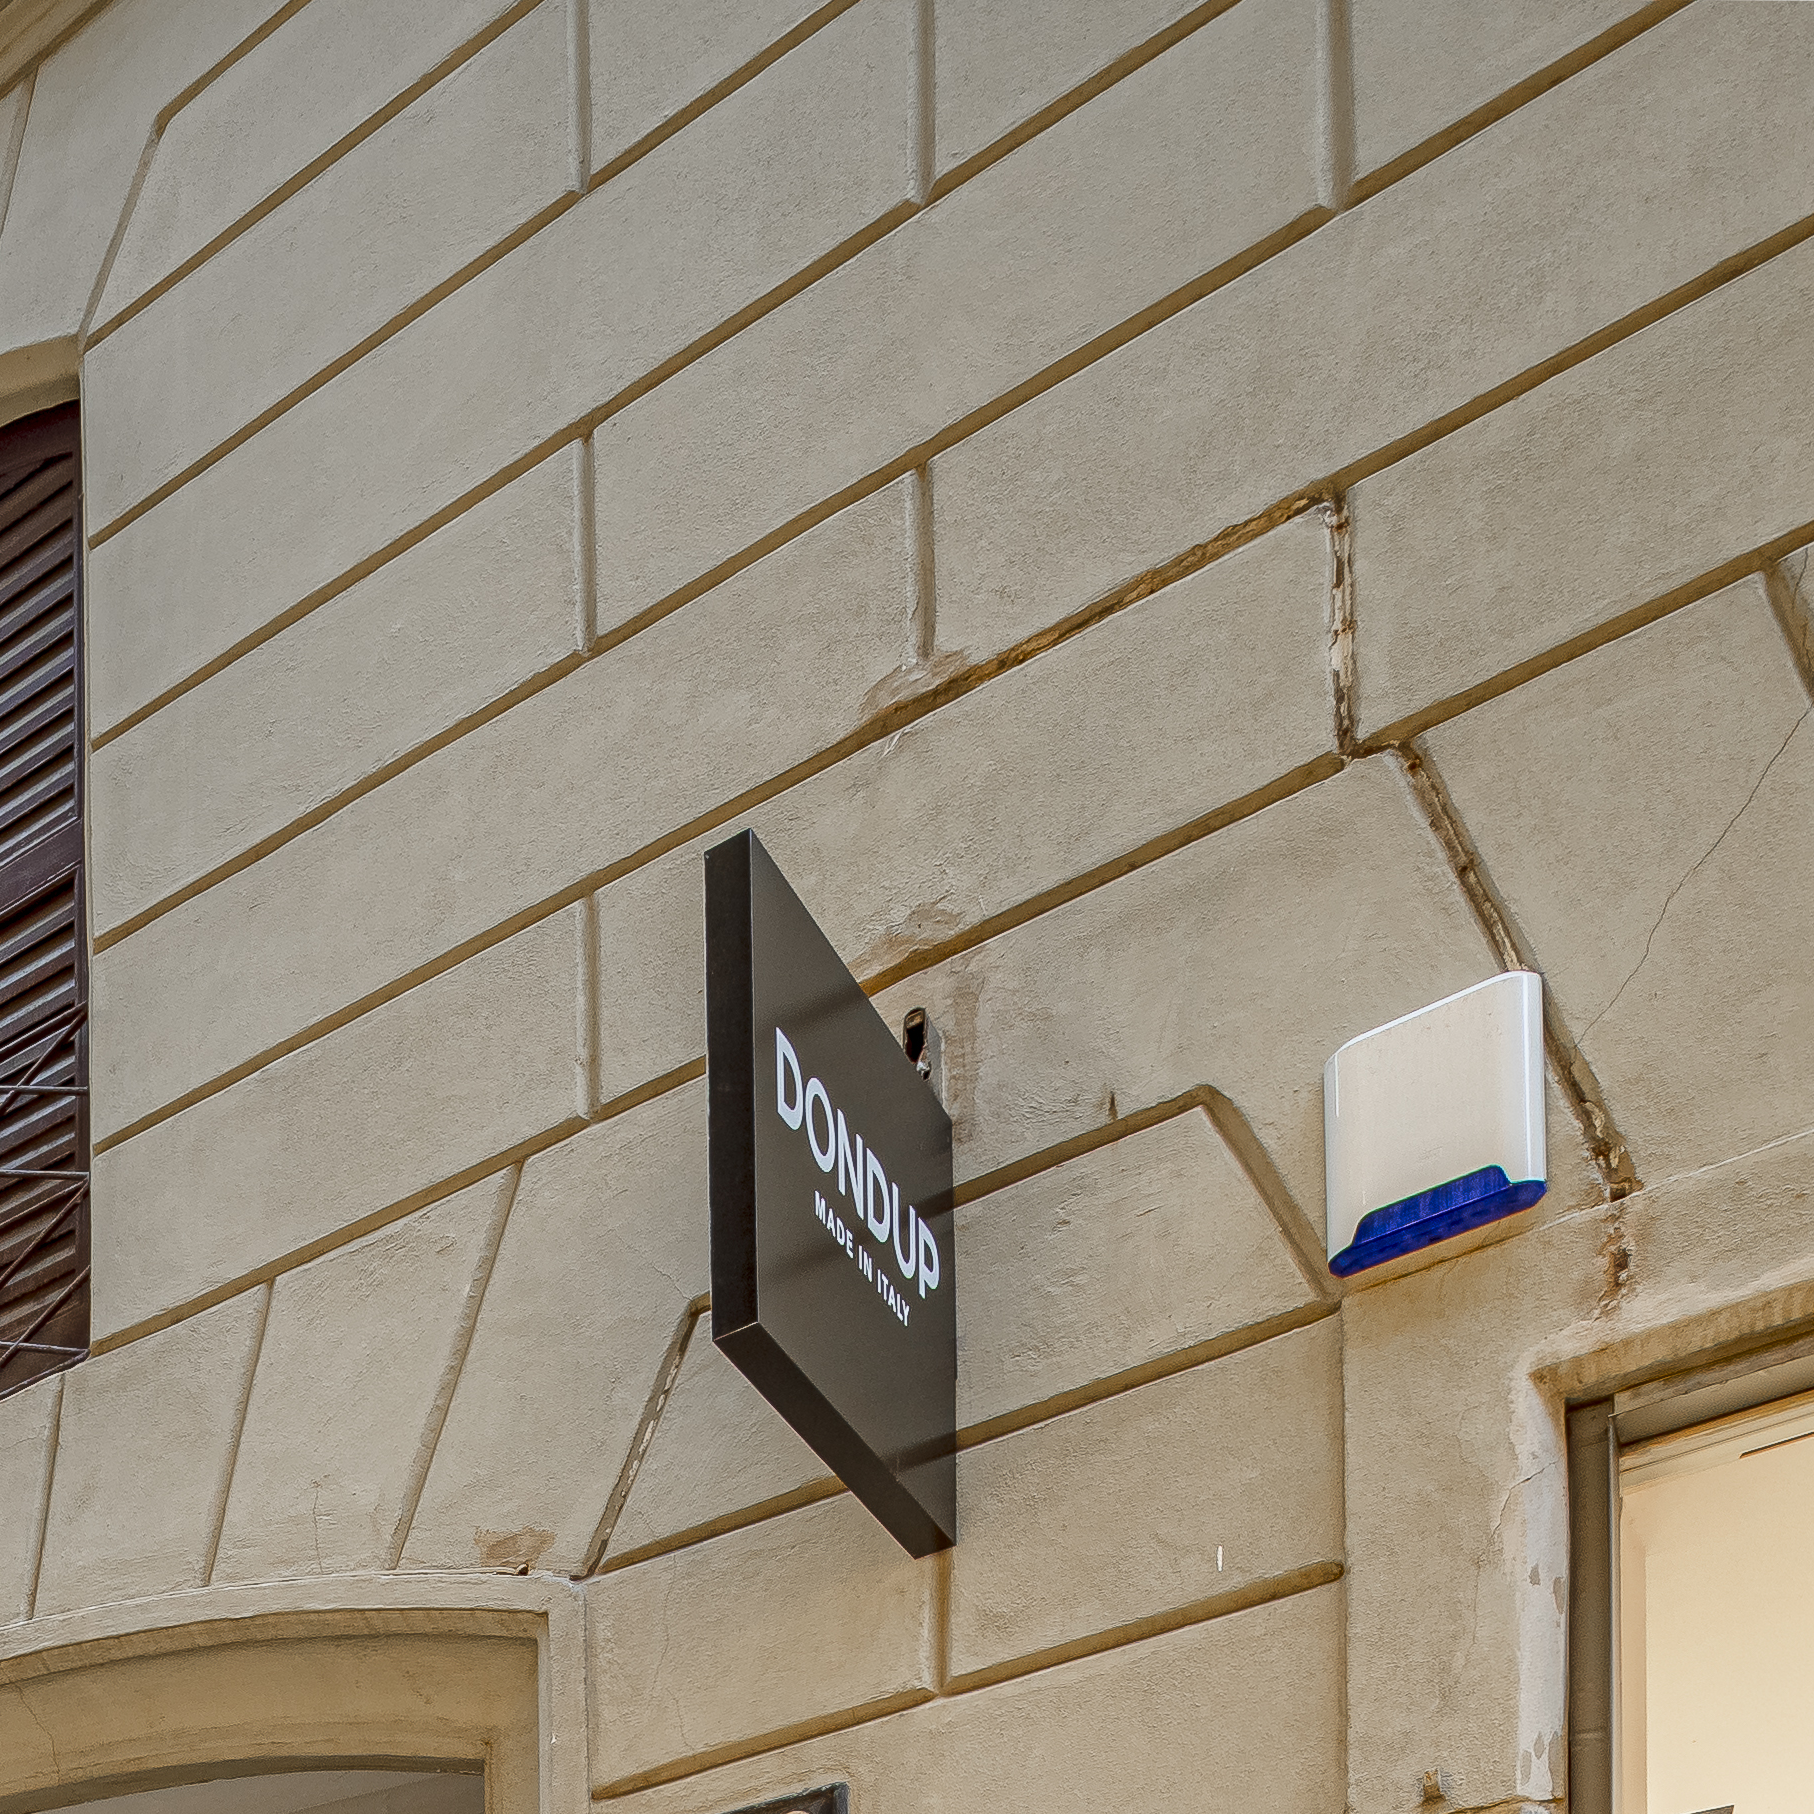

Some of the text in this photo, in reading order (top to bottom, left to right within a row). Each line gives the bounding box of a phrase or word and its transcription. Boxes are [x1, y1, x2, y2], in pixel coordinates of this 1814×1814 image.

[775, 1026, 940, 1299] DONDUP
[814, 1190, 911, 1327] MADE IN ITALY
